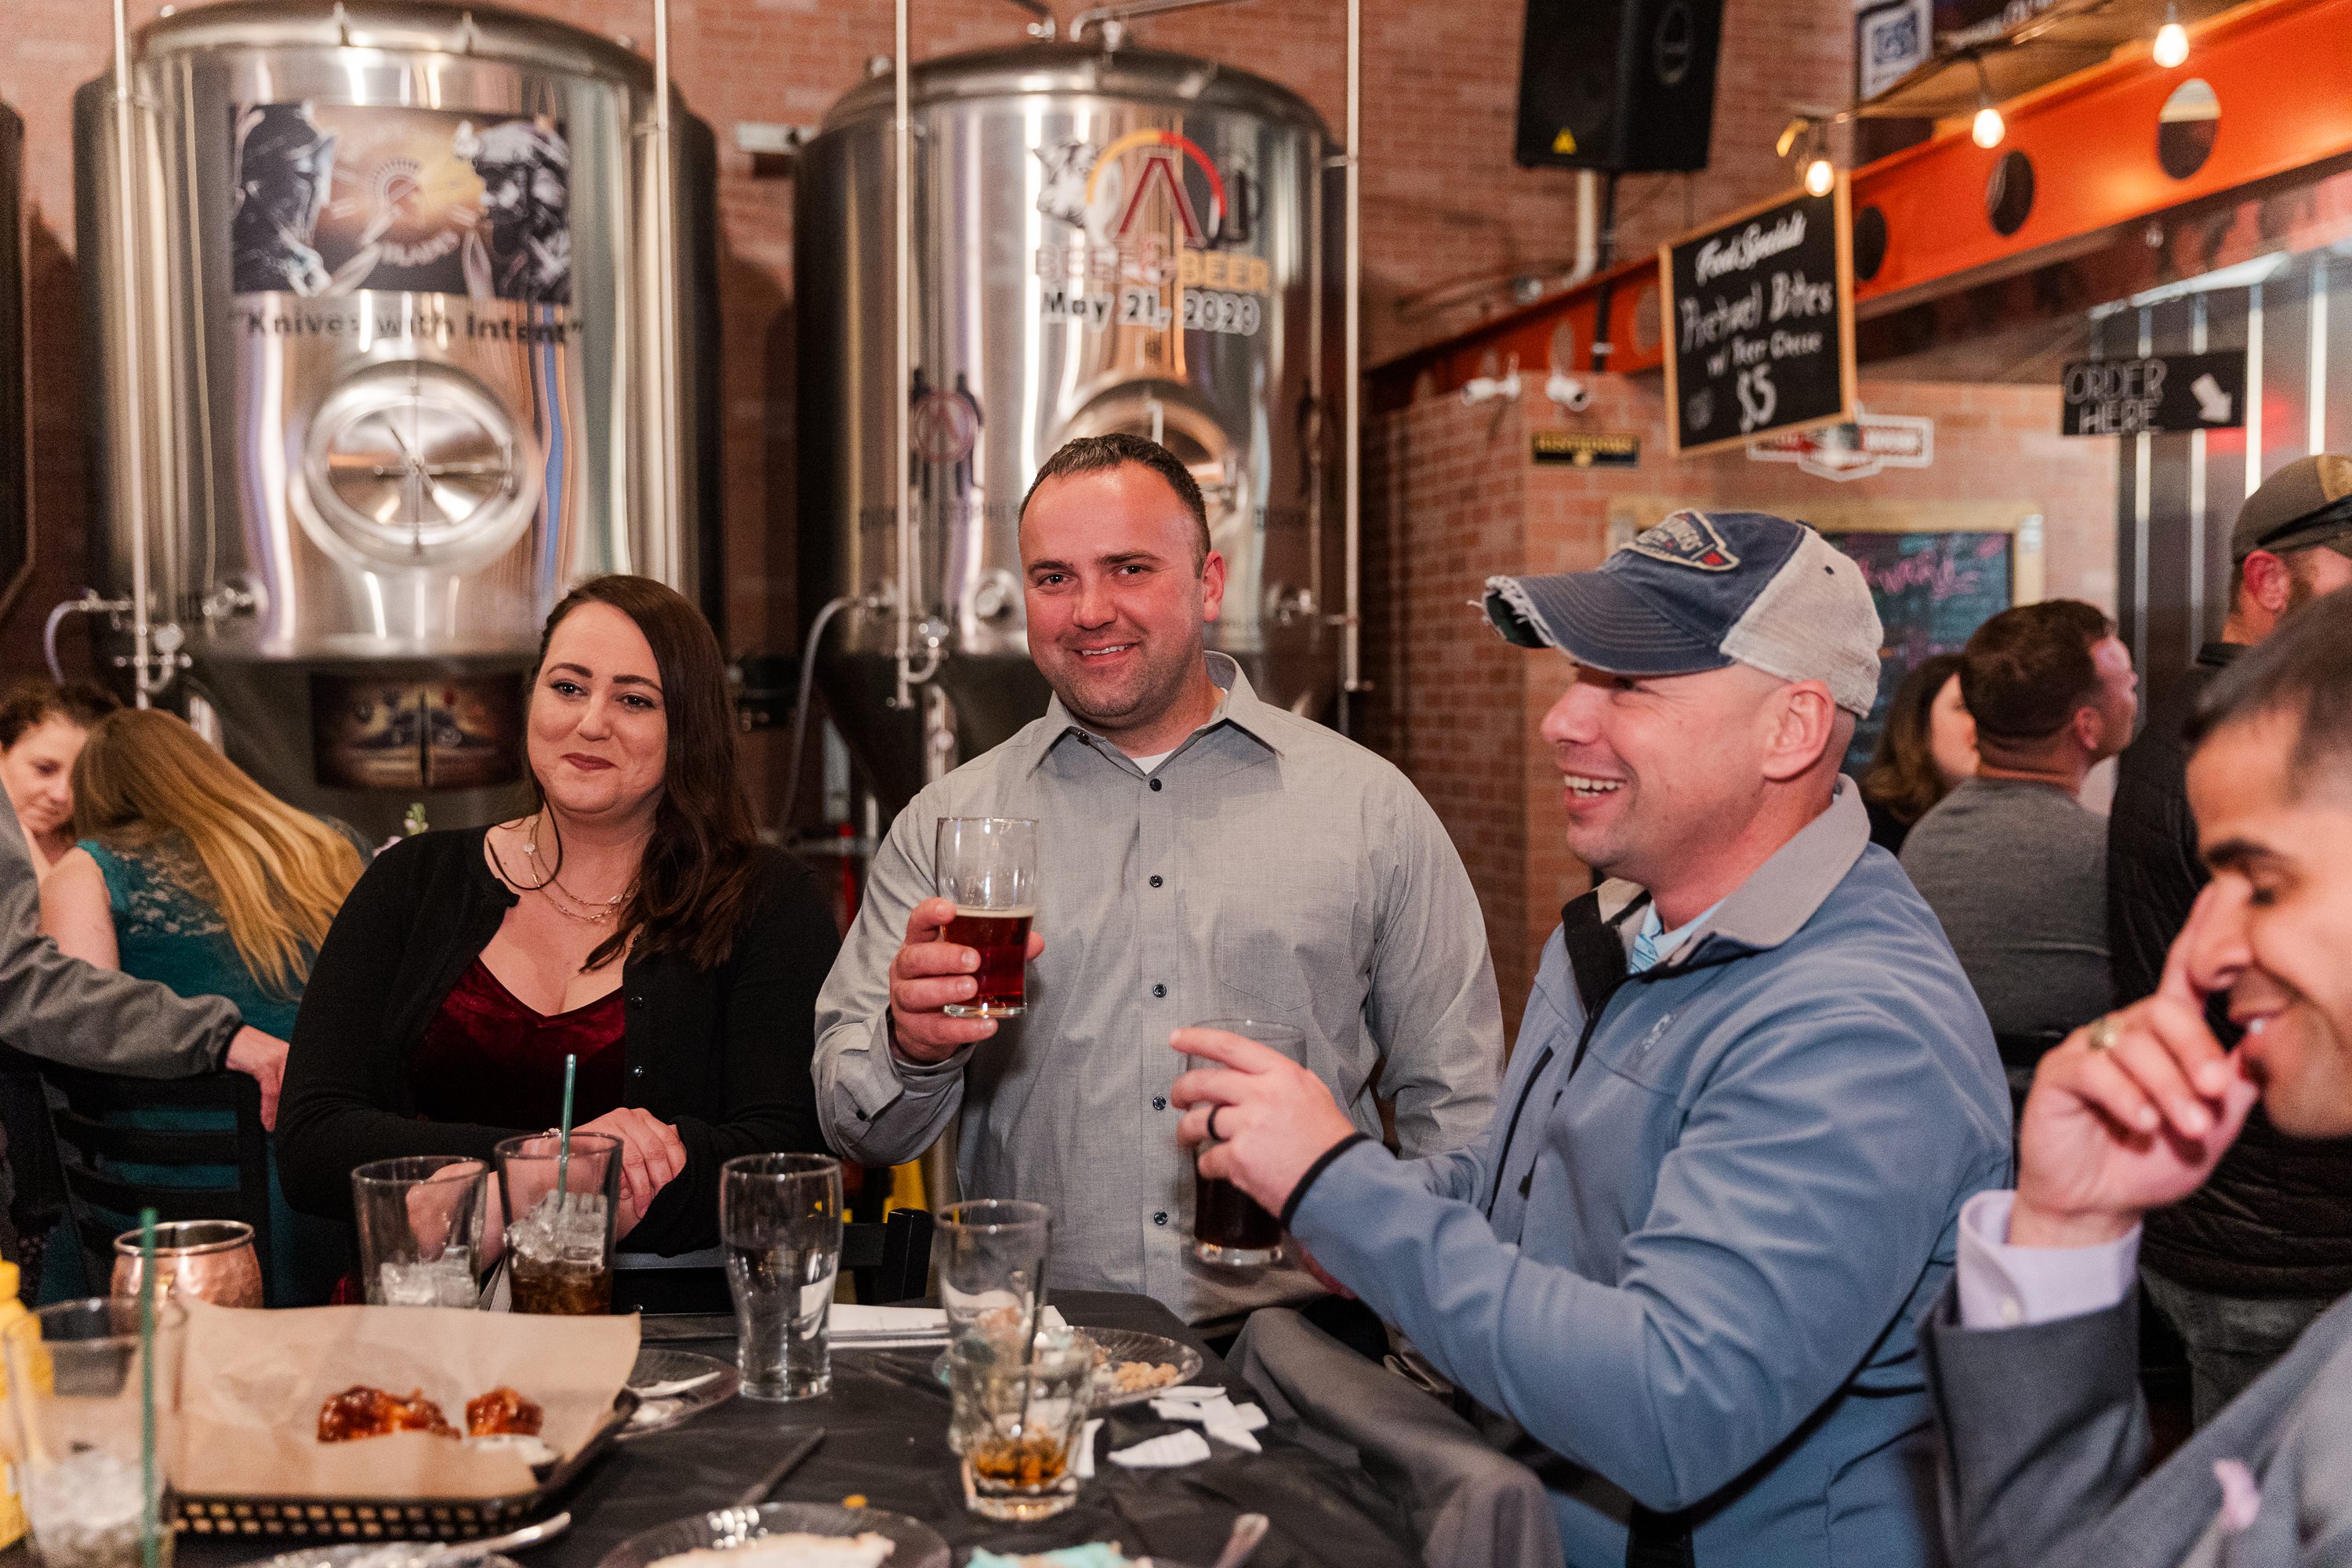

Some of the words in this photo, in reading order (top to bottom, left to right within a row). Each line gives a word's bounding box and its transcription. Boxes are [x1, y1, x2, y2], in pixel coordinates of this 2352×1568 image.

[1178, 249, 1269, 295] BEER
[1736, 362, 1777, 434] $5
[2064, 358, 2167, 407] ORDER
[2078, 397, 2164, 434] HERE
